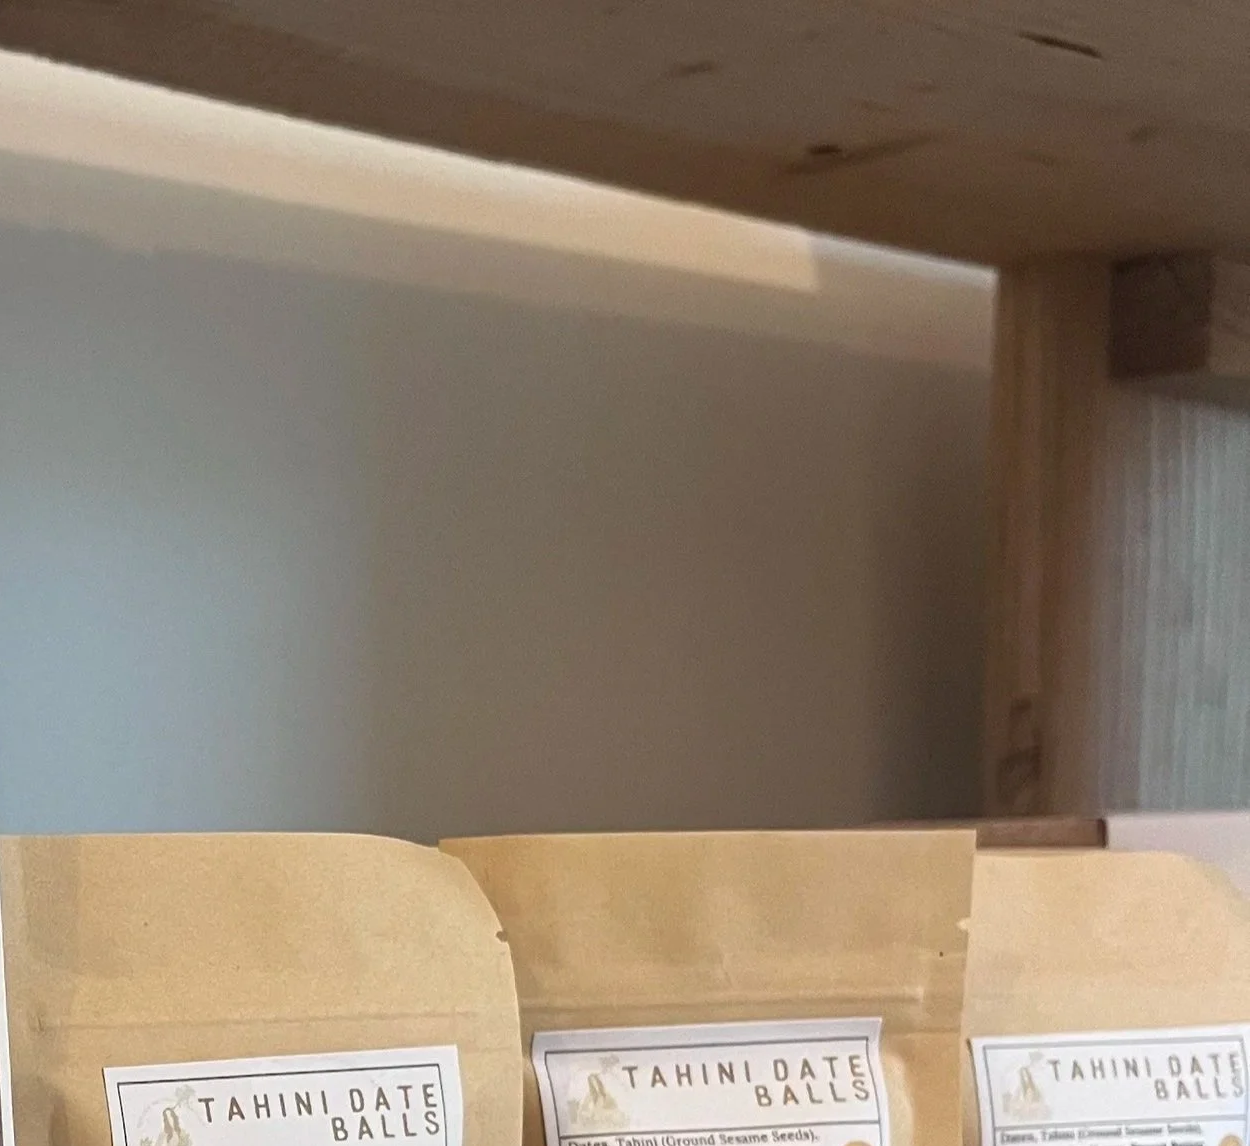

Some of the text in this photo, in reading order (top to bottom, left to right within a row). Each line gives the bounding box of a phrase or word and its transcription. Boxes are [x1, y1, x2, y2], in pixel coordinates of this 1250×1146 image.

[622, 1054, 865, 1089] TAHINI DATE
[1048, 1050, 1242, 1082] TAHINI DATE
[198, 1083, 438, 1124] TAHINI DATE
[755, 1079, 870, 1108] BALLS
[1154, 1075, 1245, 1101] BALLS
[332, 1111, 441, 1142] BALLS
